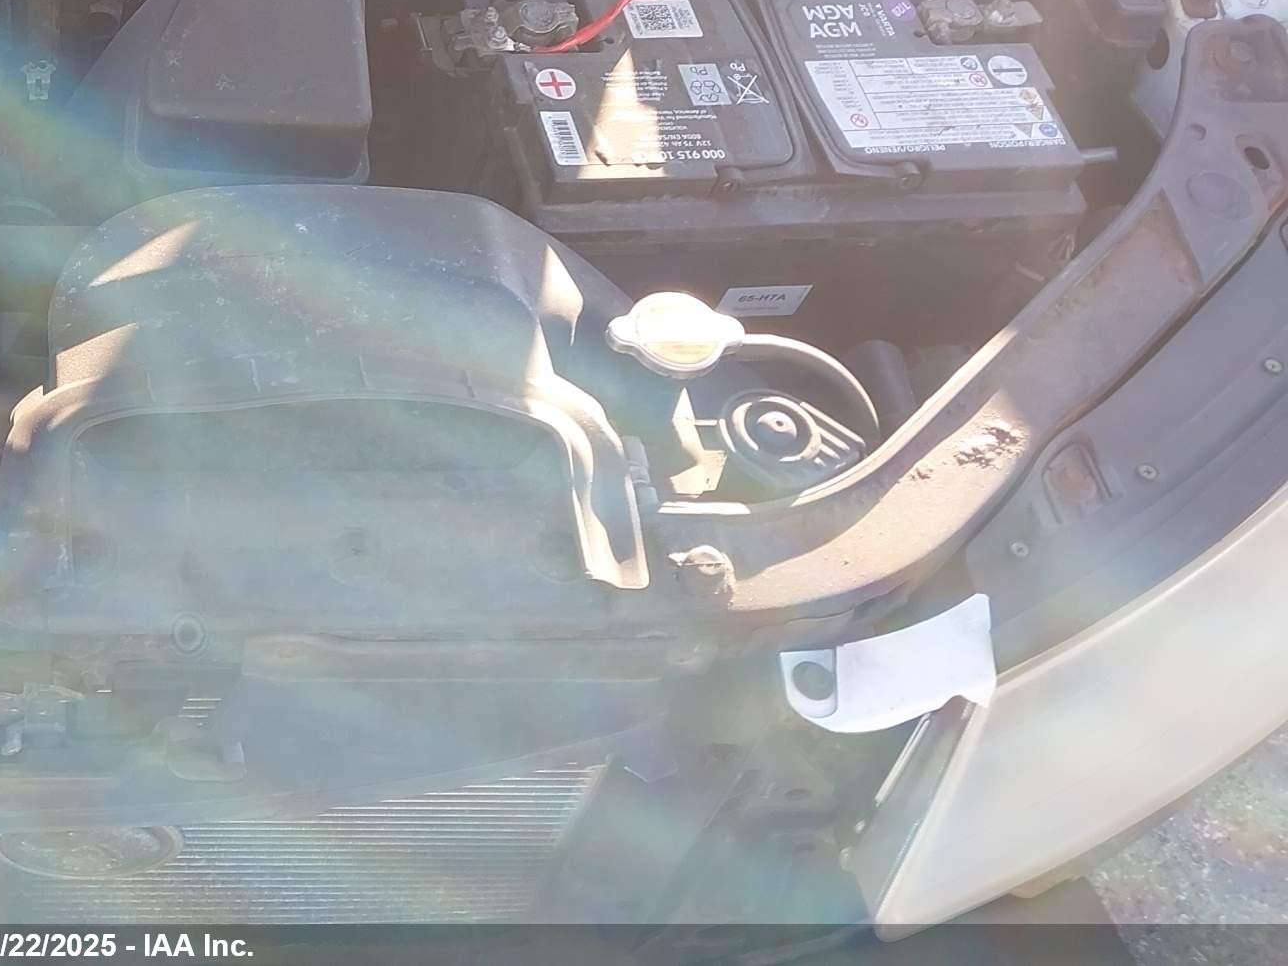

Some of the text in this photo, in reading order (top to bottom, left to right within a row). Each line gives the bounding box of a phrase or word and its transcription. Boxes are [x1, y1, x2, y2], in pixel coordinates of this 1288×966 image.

[802, 3, 854, 21] AGM
[810, 21, 863, 39] AGM
[690, 66, 708, 76] Pb
[729, 62, 746, 72] Pb
[677, 149, 700, 160] 915
[702, 149, 726, 160] 000
